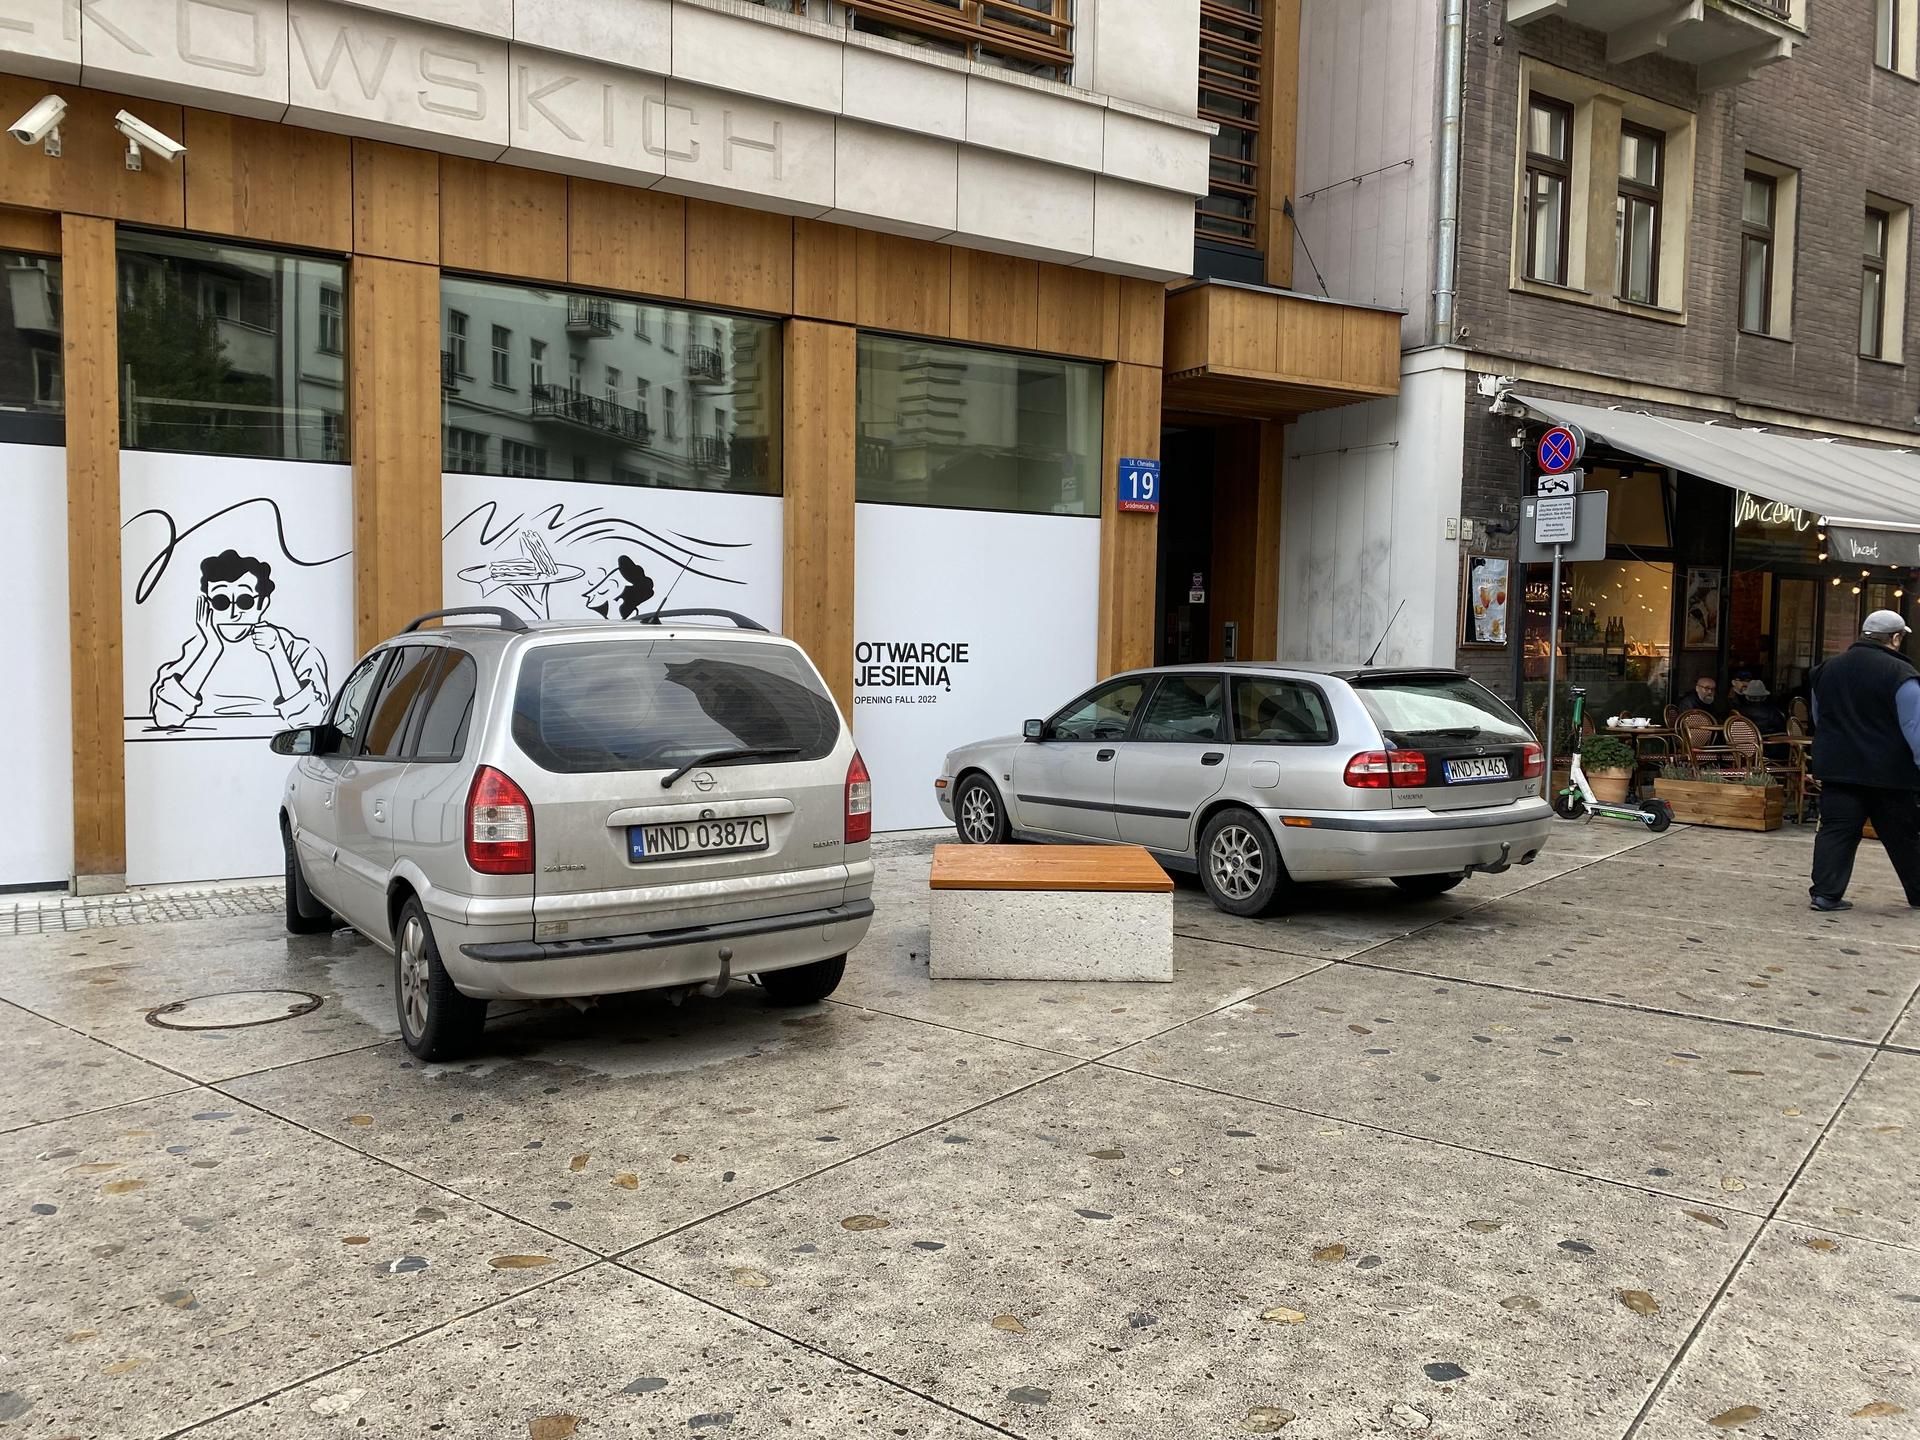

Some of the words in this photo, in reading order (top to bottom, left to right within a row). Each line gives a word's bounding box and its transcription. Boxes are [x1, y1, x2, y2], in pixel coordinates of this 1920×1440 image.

[0, 0, 783, 180] KOWSKICH
[1129, 471, 1154, 500] 19
[1850, 538, 1881, 559] Vincent
[855, 641, 969, 664] OTWARCIE
[854, 665, 952, 693] JESIENIĄ
[854, 695, 893, 705] OPENING
[895, 695, 916, 704] FALL
[918, 695, 937, 704] 2022
[1448, 760, 1472, 779] WND
[1473, 758, 1507, 776] 51463
[633, 845, 643, 853] PL
[644, 826, 690, 854] WND
[696, 820, 765, 848] 0387C
[544, 863, 587, 873] ZAFIRA
